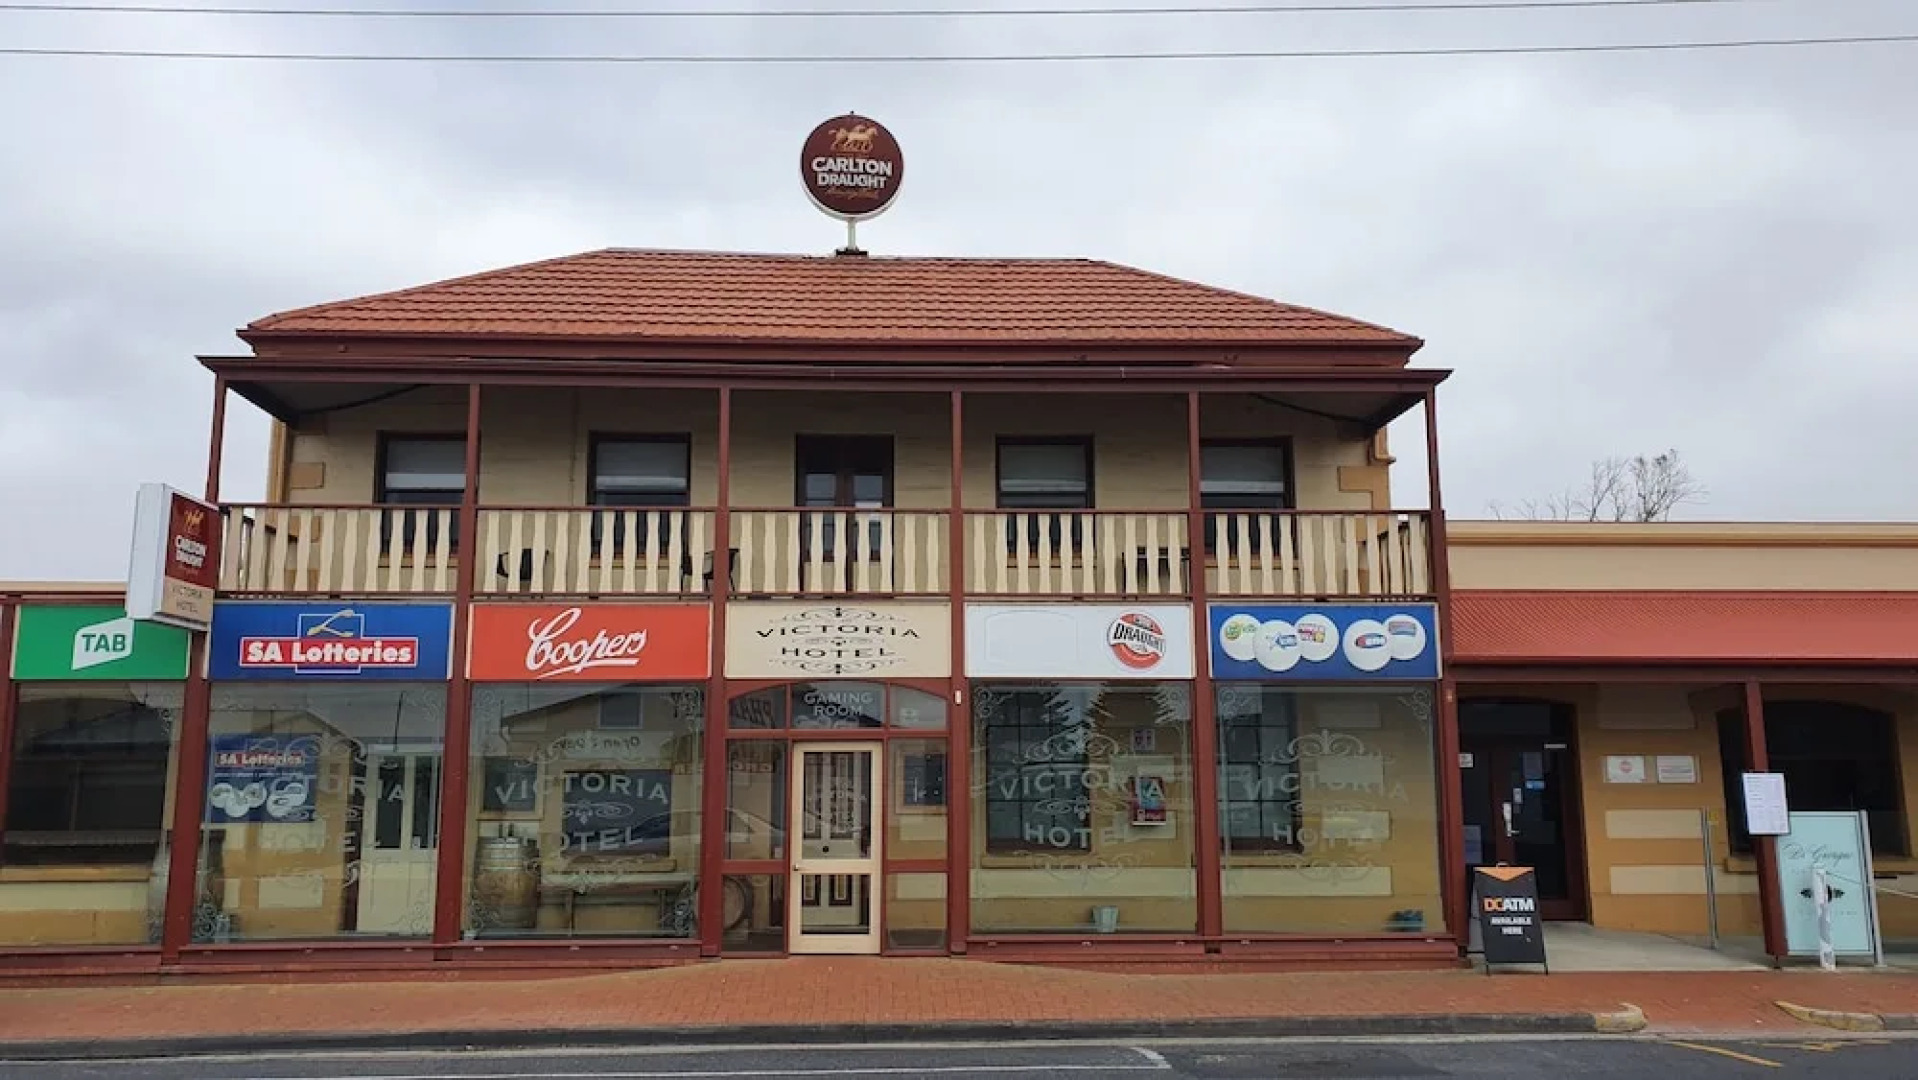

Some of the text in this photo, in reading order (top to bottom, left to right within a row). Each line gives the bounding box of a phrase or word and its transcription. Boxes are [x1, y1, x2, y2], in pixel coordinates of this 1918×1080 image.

[812, 156, 893, 177] CARLTON
[817, 172, 886, 188] DRAUGHT
[525, 607, 648, 674] Coopers
[756, 623, 920, 639] VICTORIA
[82, 634, 126, 653] TAB
[247, 641, 412, 662] SA Lotteries
[781, 648, 896, 658] HOTEL
[803, 692, 873, 704] GAMING
[813, 705, 862, 717] ROOM
[495, 773, 669, 805] VICTORIA
[1000, 770, 1164, 801] VICTORIA
[1243, 772, 1410, 805] VICTORIA
